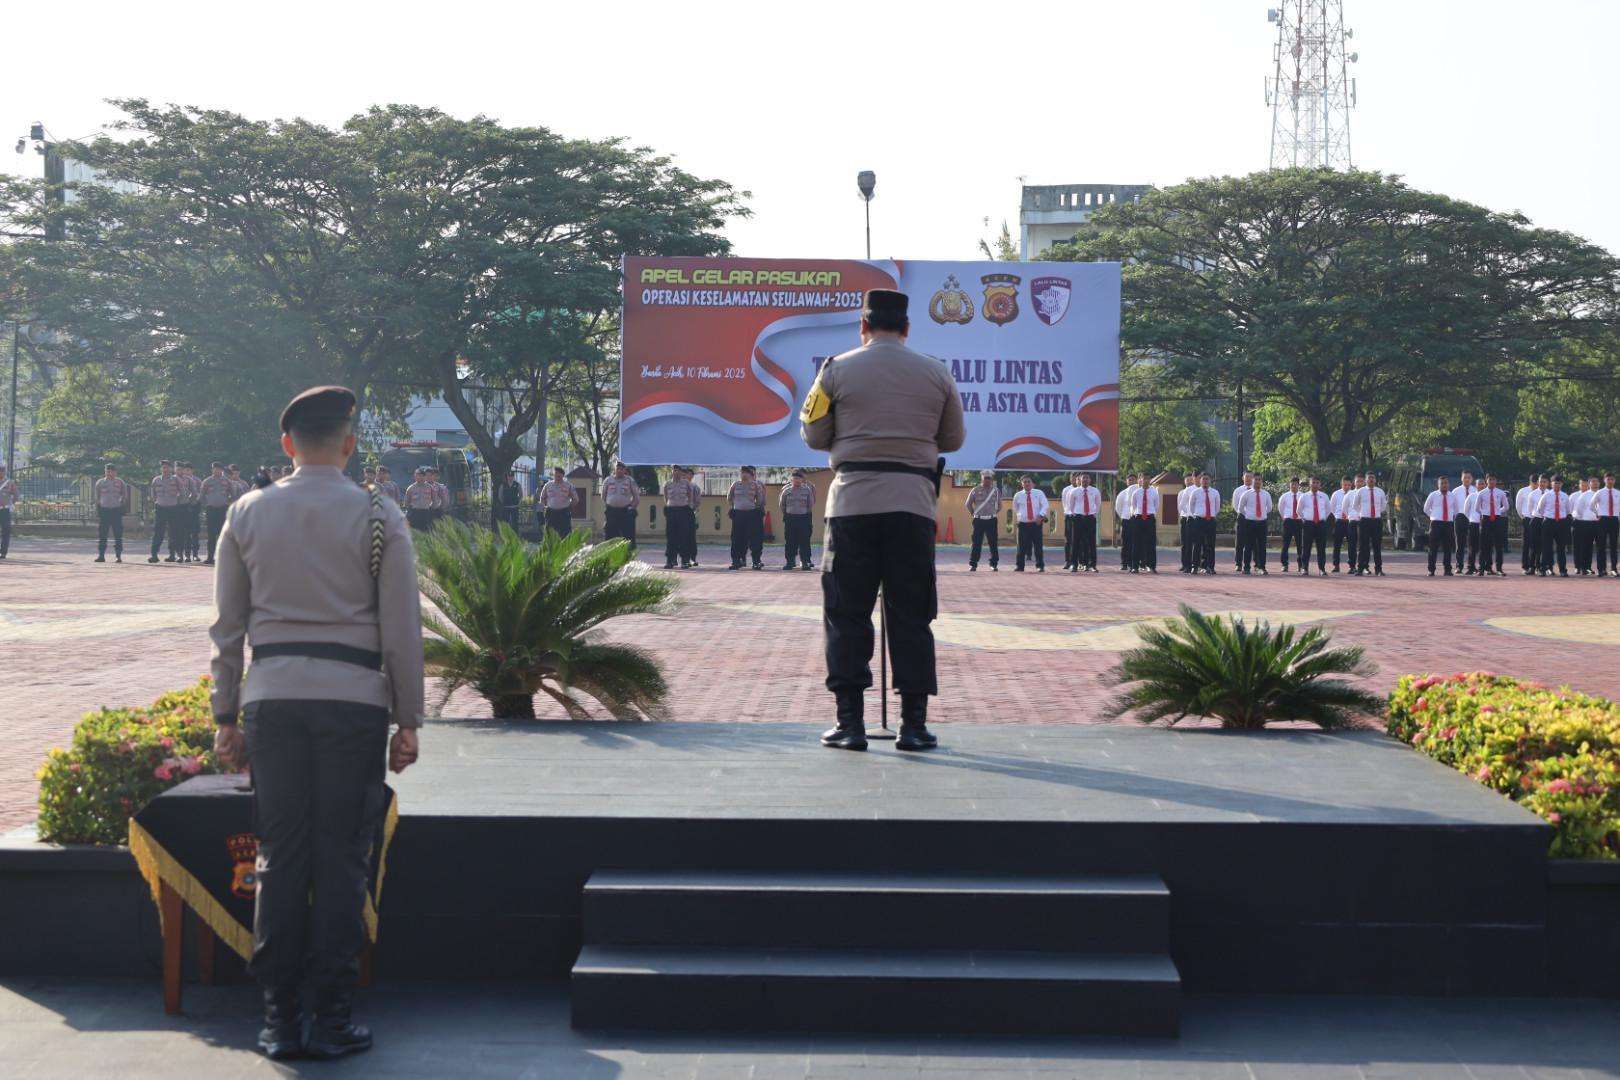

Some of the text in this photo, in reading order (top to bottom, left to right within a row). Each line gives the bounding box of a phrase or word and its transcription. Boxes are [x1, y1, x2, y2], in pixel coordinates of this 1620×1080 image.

[641, 269, 841, 286] APEL GELAR PASUKAN
[641, 288, 862, 307] OPERASI KESELAMATAN SEULAWAH-2025
[687, 367, 697, 378] 10
[724, 367, 746, 379] 2025
[939, 359, 1063, 384] ALU LINTAS
[986, 392, 1028, 413] ASTA
[1034, 393, 1072, 414] CITA
